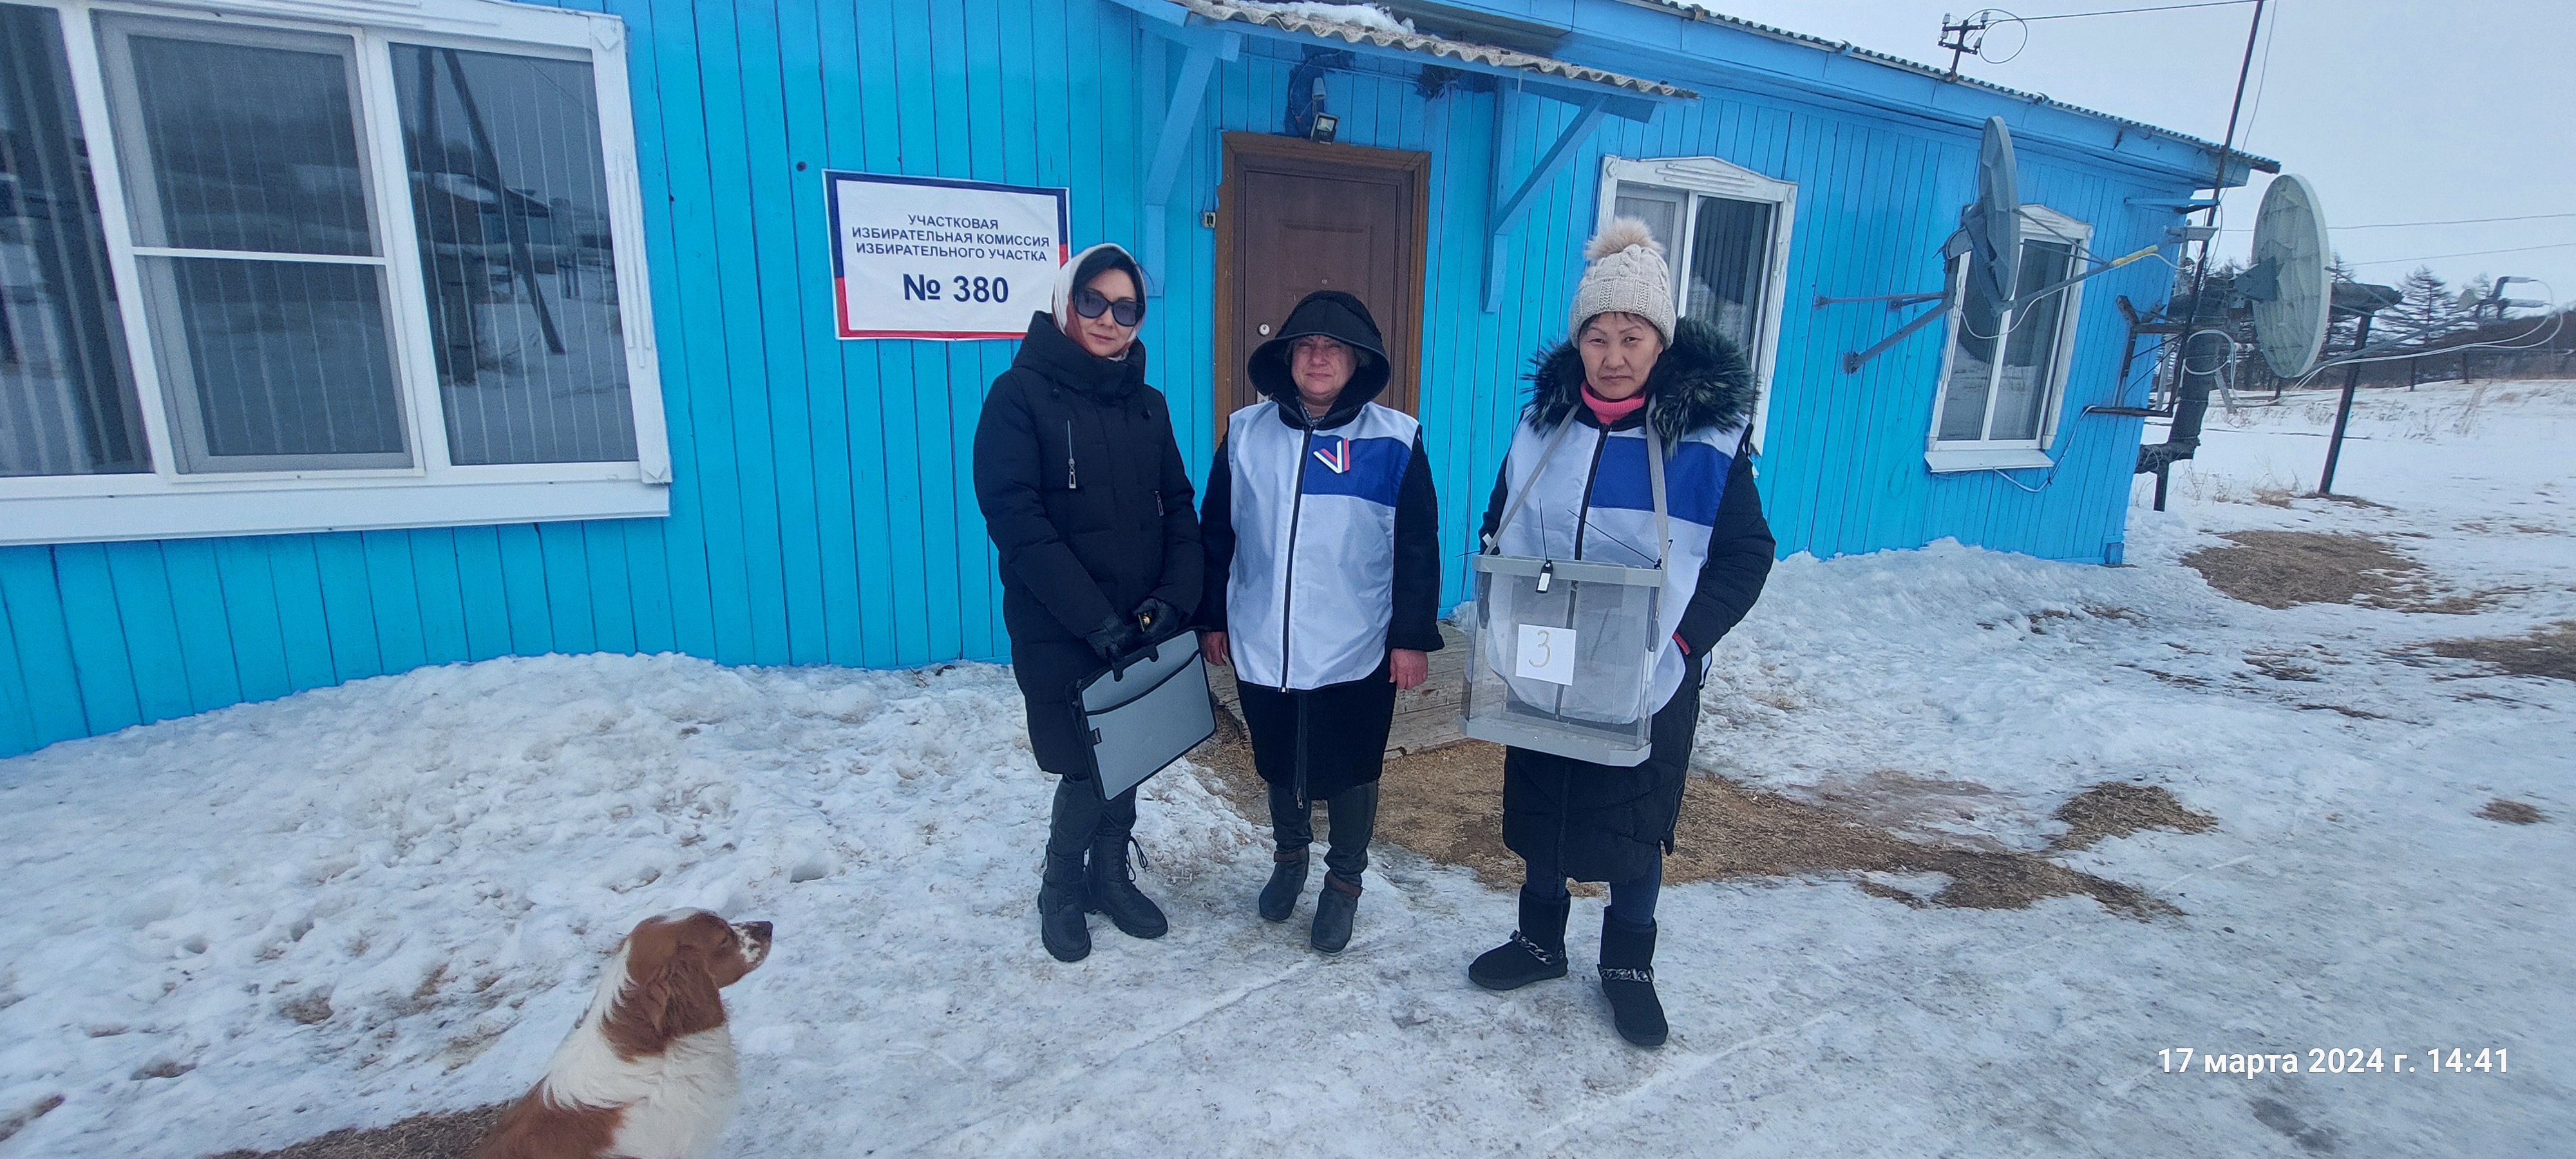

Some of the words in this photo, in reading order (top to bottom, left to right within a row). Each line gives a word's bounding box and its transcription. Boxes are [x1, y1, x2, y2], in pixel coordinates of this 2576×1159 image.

[907, 214, 998, 231] УЧАСТКОВАЯ
[851, 227, 973, 244] ИЗБИРАТЕЛЬНАЯ
[976, 233, 1050, 247] КОМИССИЯ
[856, 242, 985, 259] ИЗБИРАТЕЛЬНОГО
[988, 249, 1047, 261] УЧАСТКА
[902, 273, 941, 301] №
[952, 274, 1009, 304] 380
[1528, 628, 1551, 668] 3
